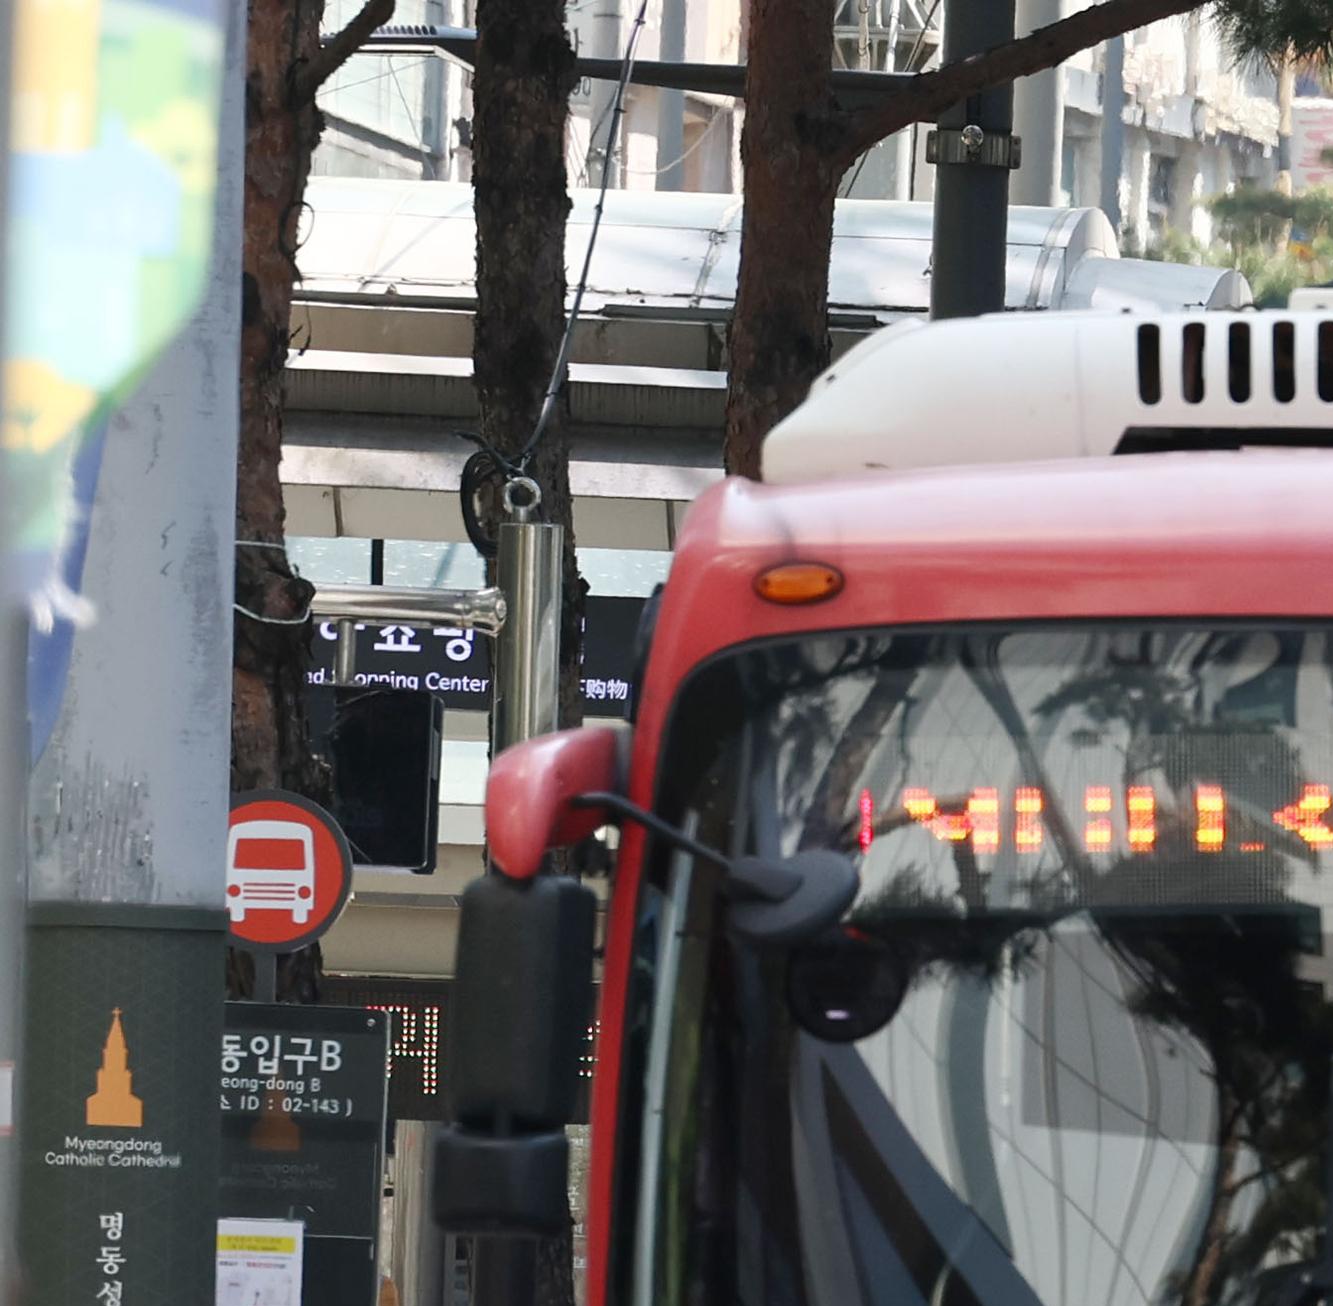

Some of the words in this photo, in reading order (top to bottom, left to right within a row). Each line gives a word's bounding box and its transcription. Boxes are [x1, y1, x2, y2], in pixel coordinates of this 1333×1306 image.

[426, 671, 490, 693] Center
[310, 1078, 321, 1092] B
[240, 1096, 260, 1111] ID
[64, 1136, 162, 1152] Myeongdong
[45, 1151, 105, 1167] Catholic
[108, 1152, 181, 1169] Cathedral
